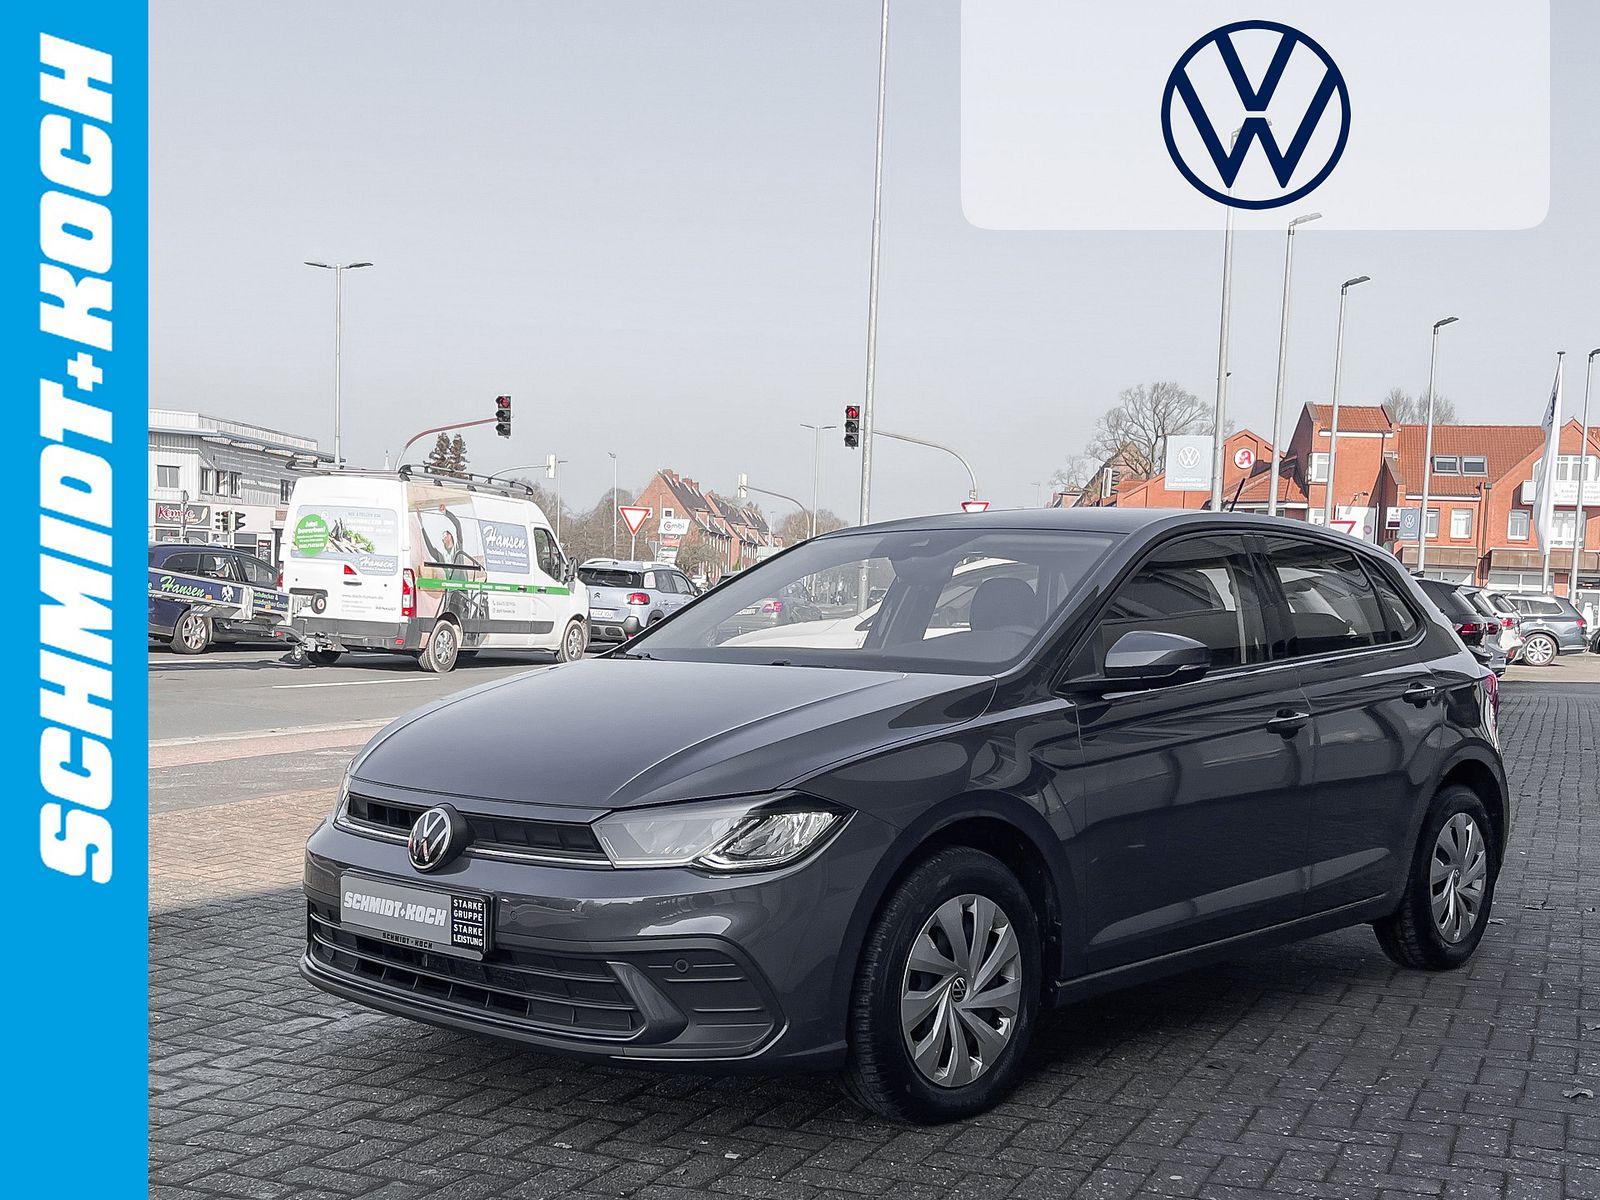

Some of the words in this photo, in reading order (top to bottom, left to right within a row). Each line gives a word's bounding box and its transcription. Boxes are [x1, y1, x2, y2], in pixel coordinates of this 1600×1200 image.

[483, 525, 526, 550] Hansen
[160, 575, 205, 598] Hansen
[343, 891, 448, 927] SCHMIDT+KOCH
[453, 899, 483, 911] STARKE
[453, 909, 483, 922] GRUPPE
[453, 924, 483, 937] STARKE
[453, 934, 483, 947] LEISTUNG
